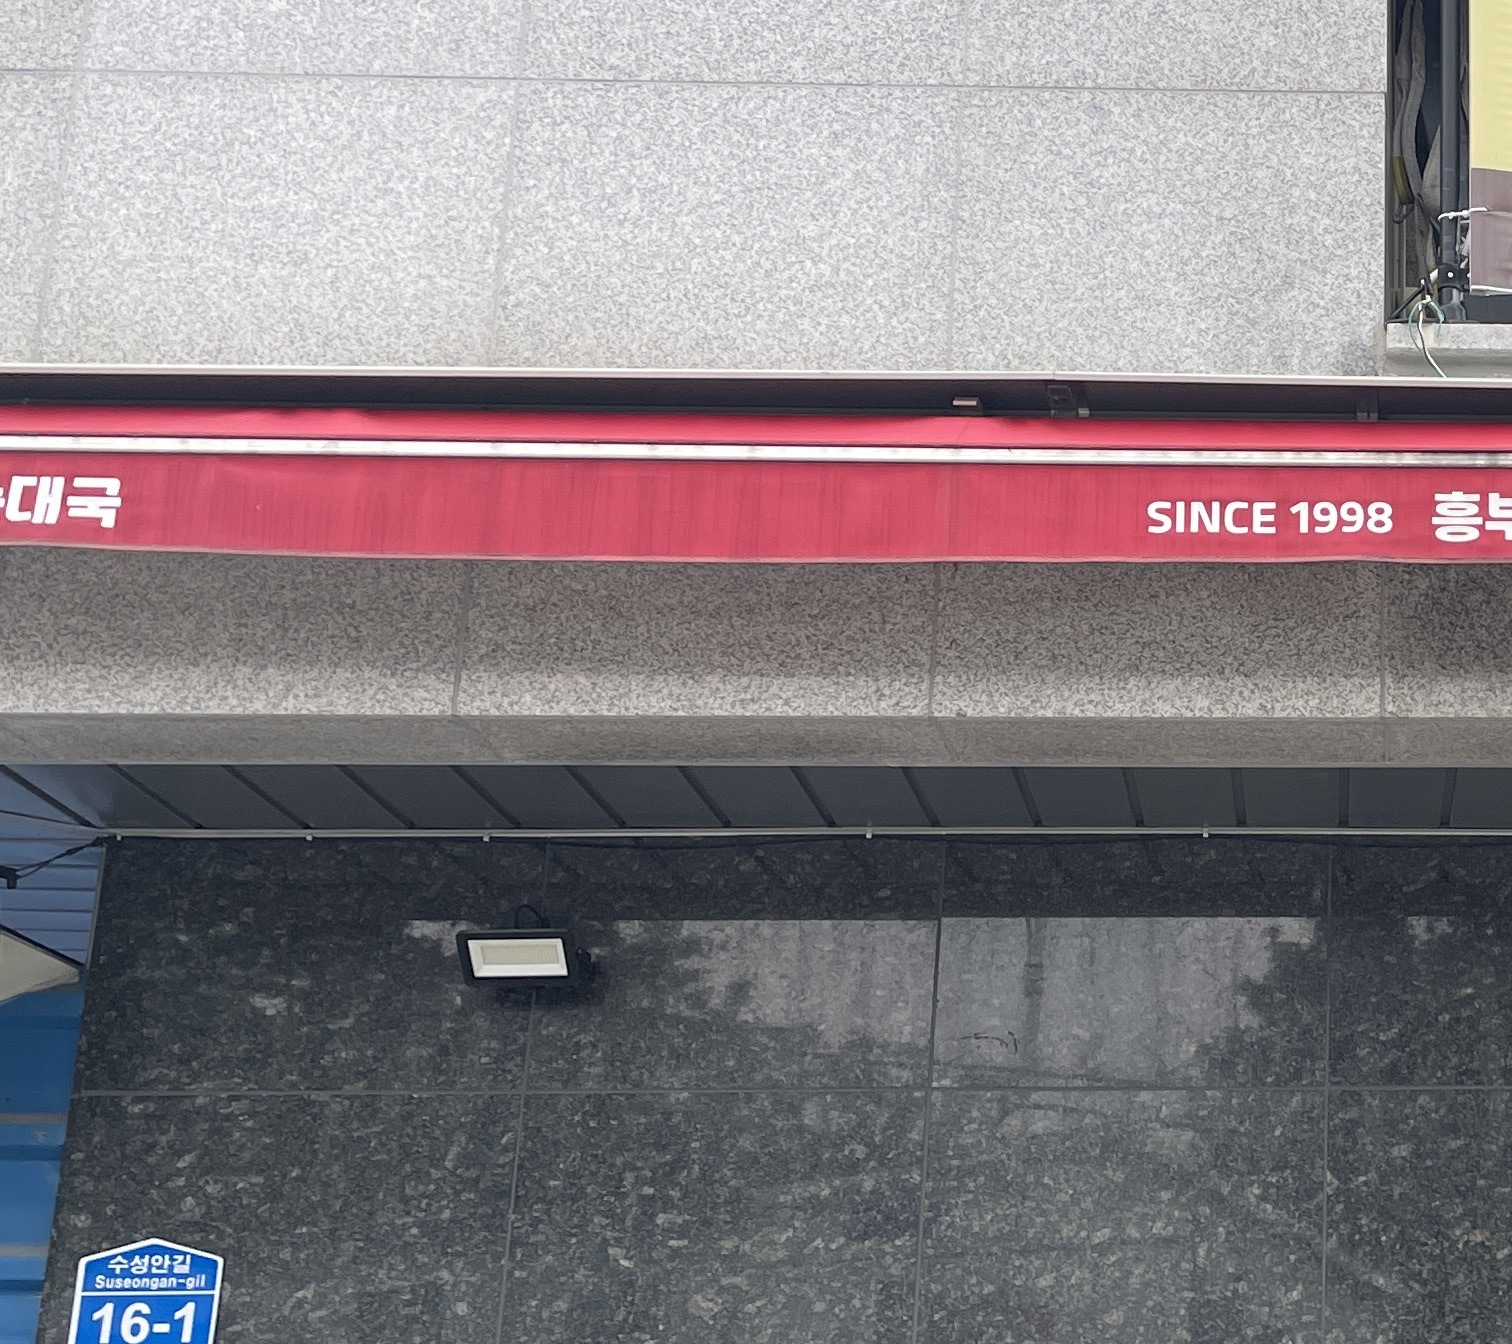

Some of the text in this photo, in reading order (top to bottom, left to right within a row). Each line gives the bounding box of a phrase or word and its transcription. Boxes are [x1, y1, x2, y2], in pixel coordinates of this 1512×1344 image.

[0, 475, 121, 529] 대국
[1147, 500, 1277, 535] SINCE
[1289, 500, 1393, 534] 1998
[107, 1254, 192, 1274] 수성안길
[94, 1274, 206, 1291] Suseongan-gil
[92, 1301, 196, 1344] 16-1
